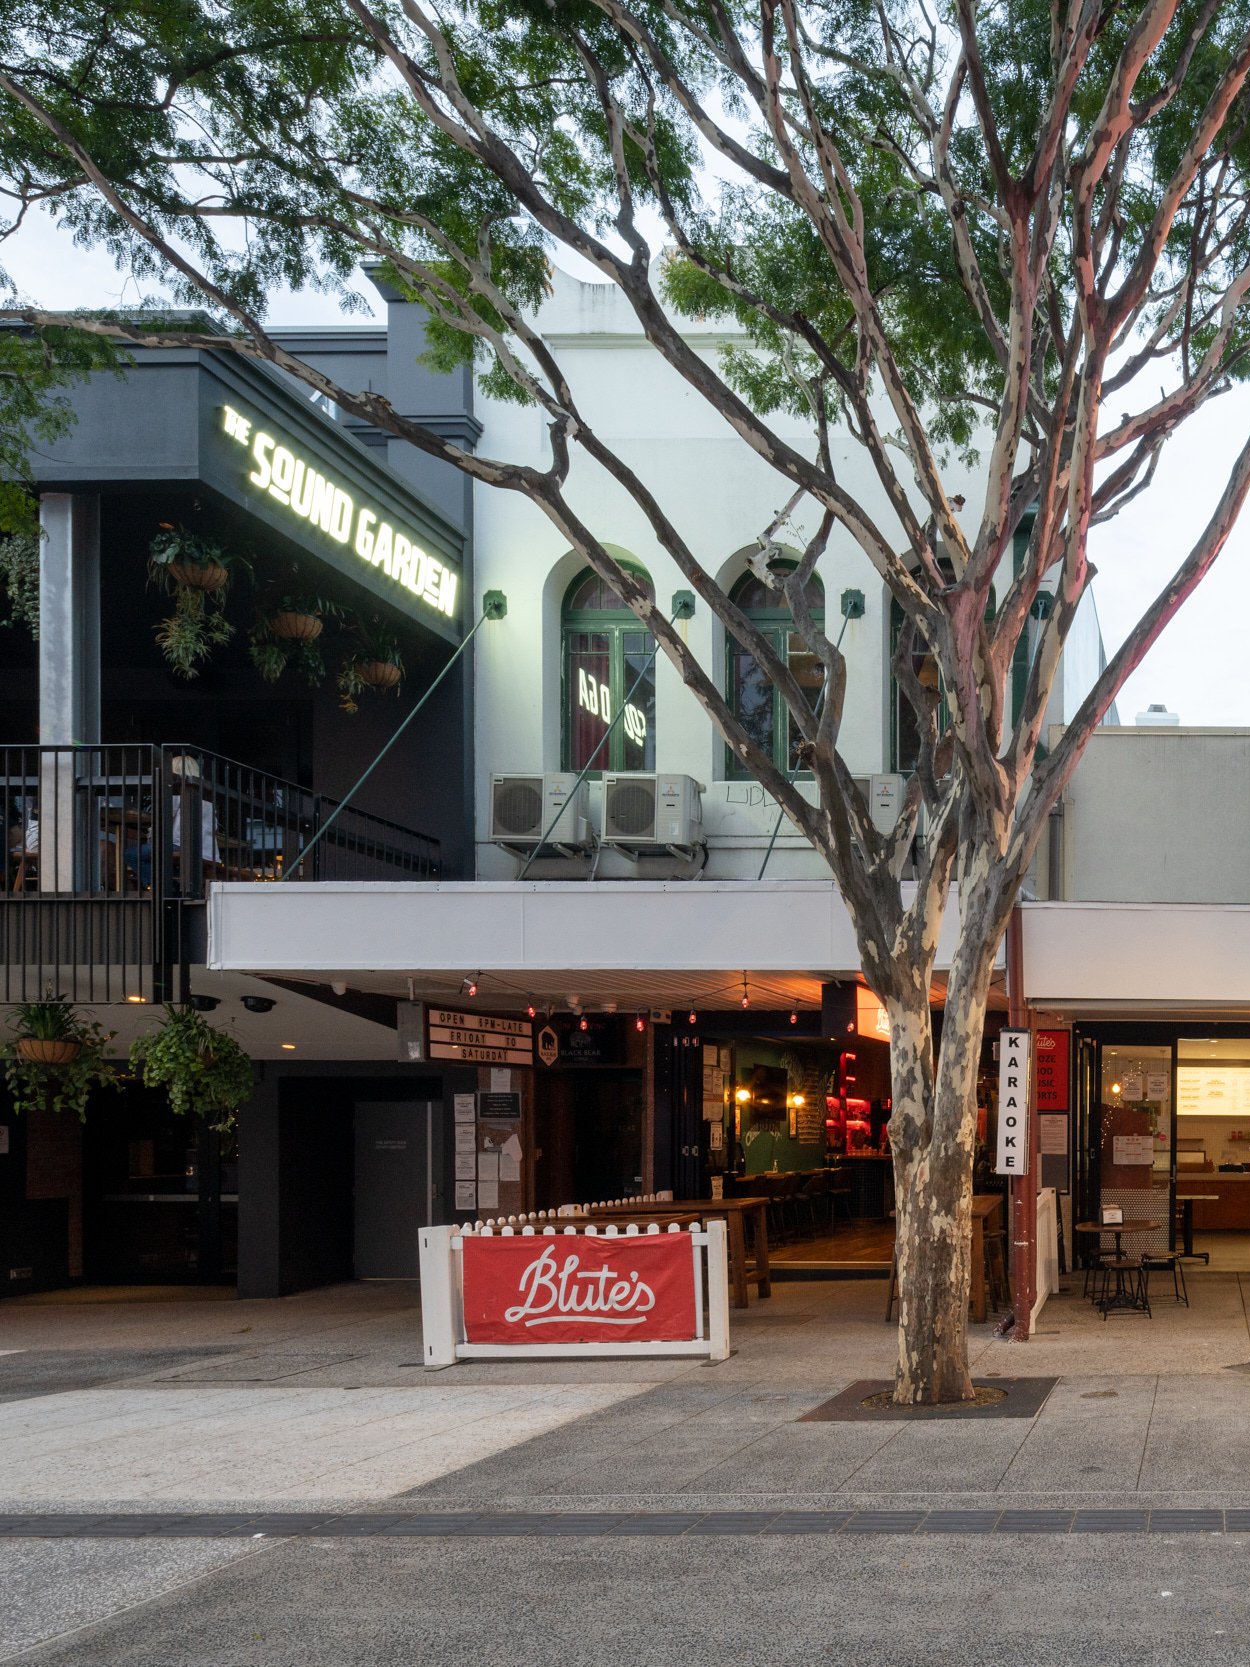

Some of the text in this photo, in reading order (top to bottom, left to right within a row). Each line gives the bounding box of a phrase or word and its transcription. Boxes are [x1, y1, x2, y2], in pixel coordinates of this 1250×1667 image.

[224, 405, 252, 446] THE
[250, 431, 458, 617] SOUND GARDEN
[439, 1012, 465, 1026] OPEN
[461, 1048, 508, 1062] SATURDAY
[505, 1036, 516, 1047] TO
[1005, 1036, 1020, 1168] KARAOKE
[504, 1244, 656, 1323] Blute's
